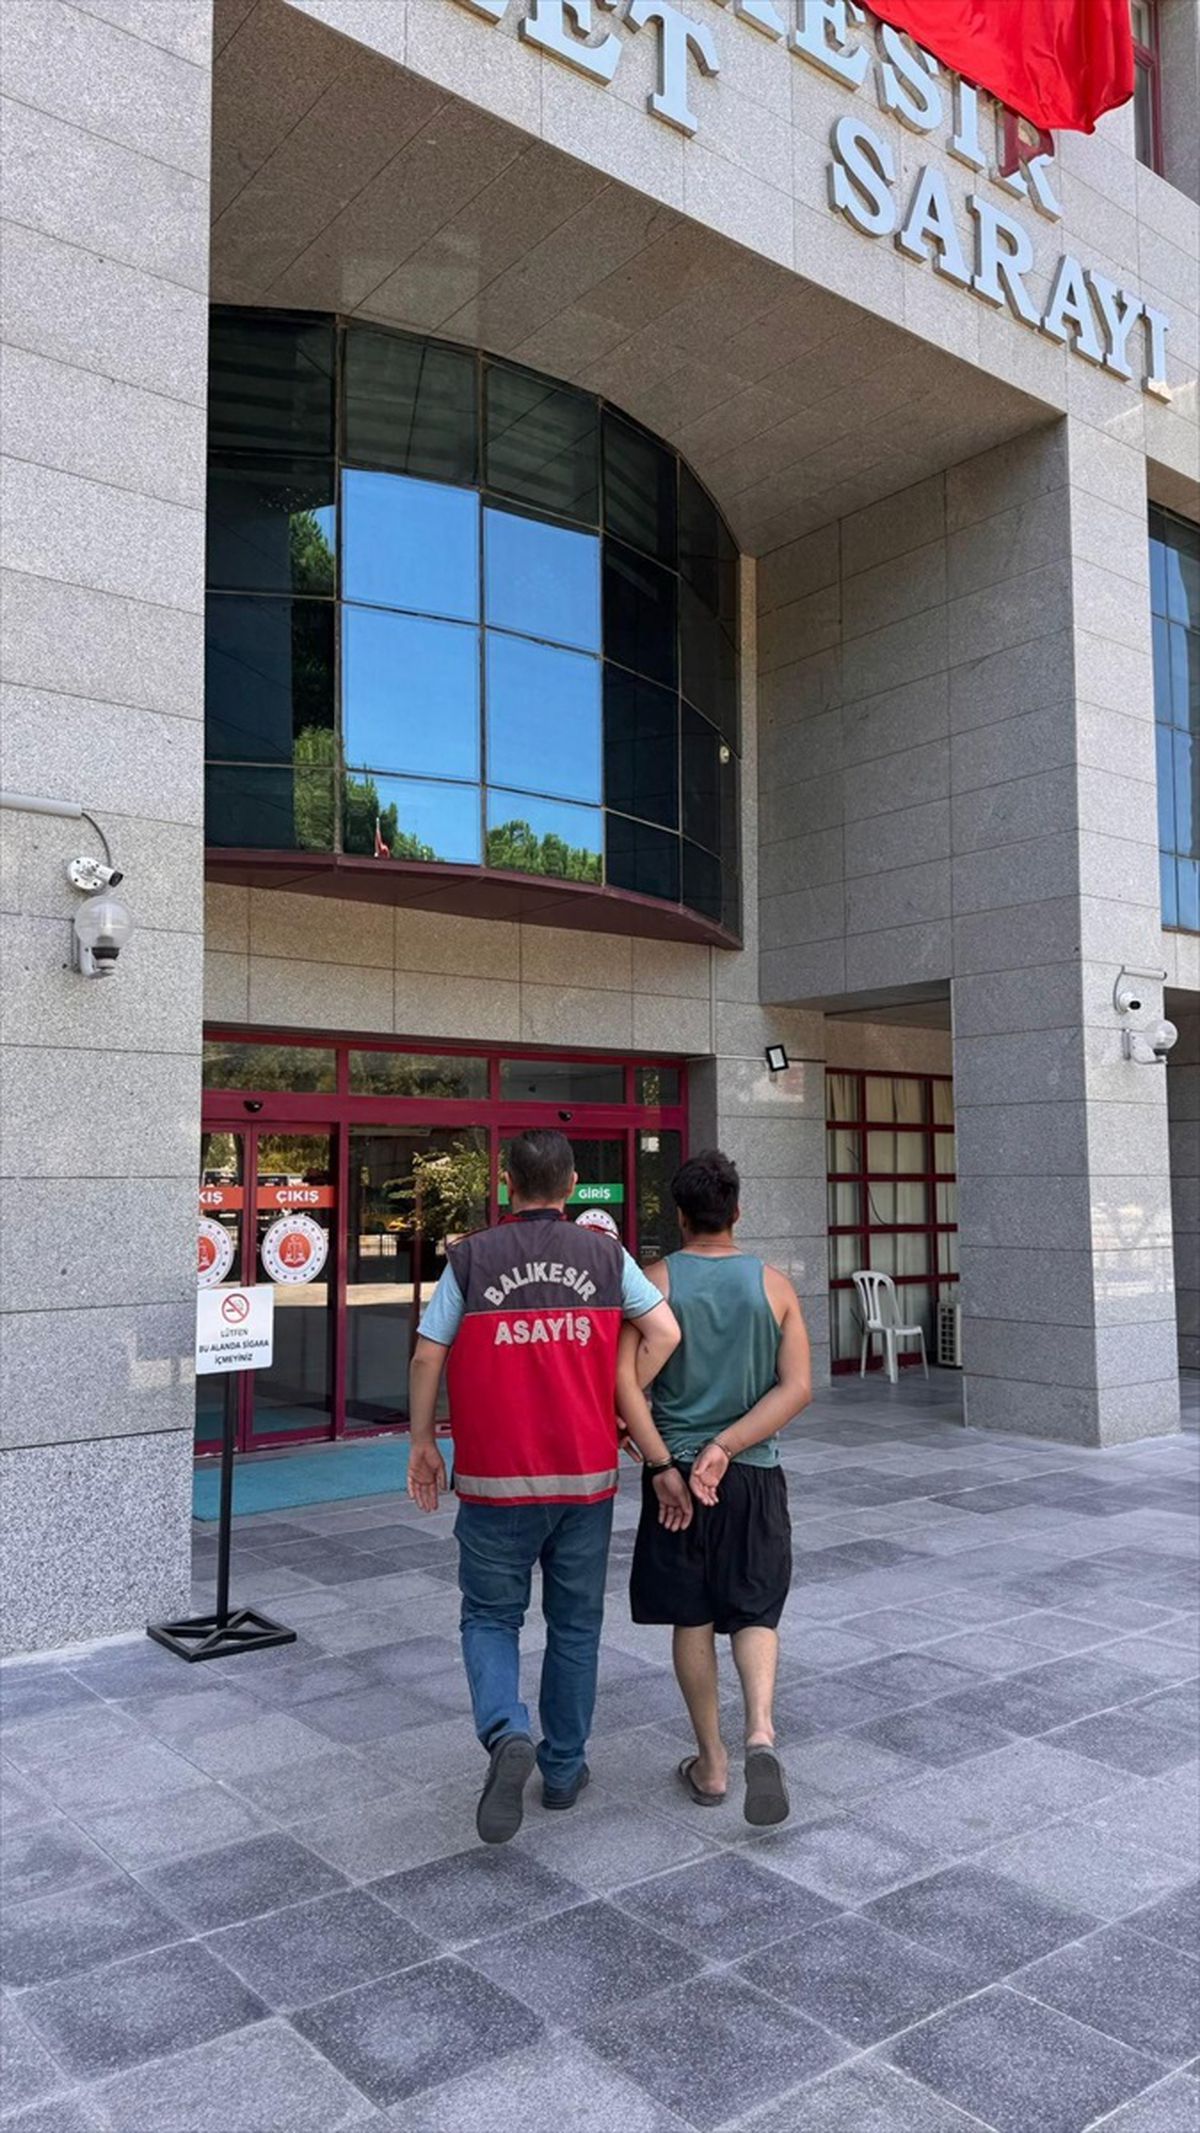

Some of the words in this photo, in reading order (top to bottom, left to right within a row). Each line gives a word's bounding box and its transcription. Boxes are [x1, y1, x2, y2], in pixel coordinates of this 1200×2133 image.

[827, 116, 1170, 402] SARAYI
[276, 1190, 320, 1205] ÇIKIŞ
[578, 1187, 611, 1200] GİRİŞ
[483, 1262, 597, 1306] BALIKESİR
[494, 1312, 591, 1346] ASAYİŞ
[210, 1342, 241, 1351] ALANDA
[242, 1340, 269, 1349] SİGARA
[215, 1353, 253, 1365] İÇMEYİNİZ
